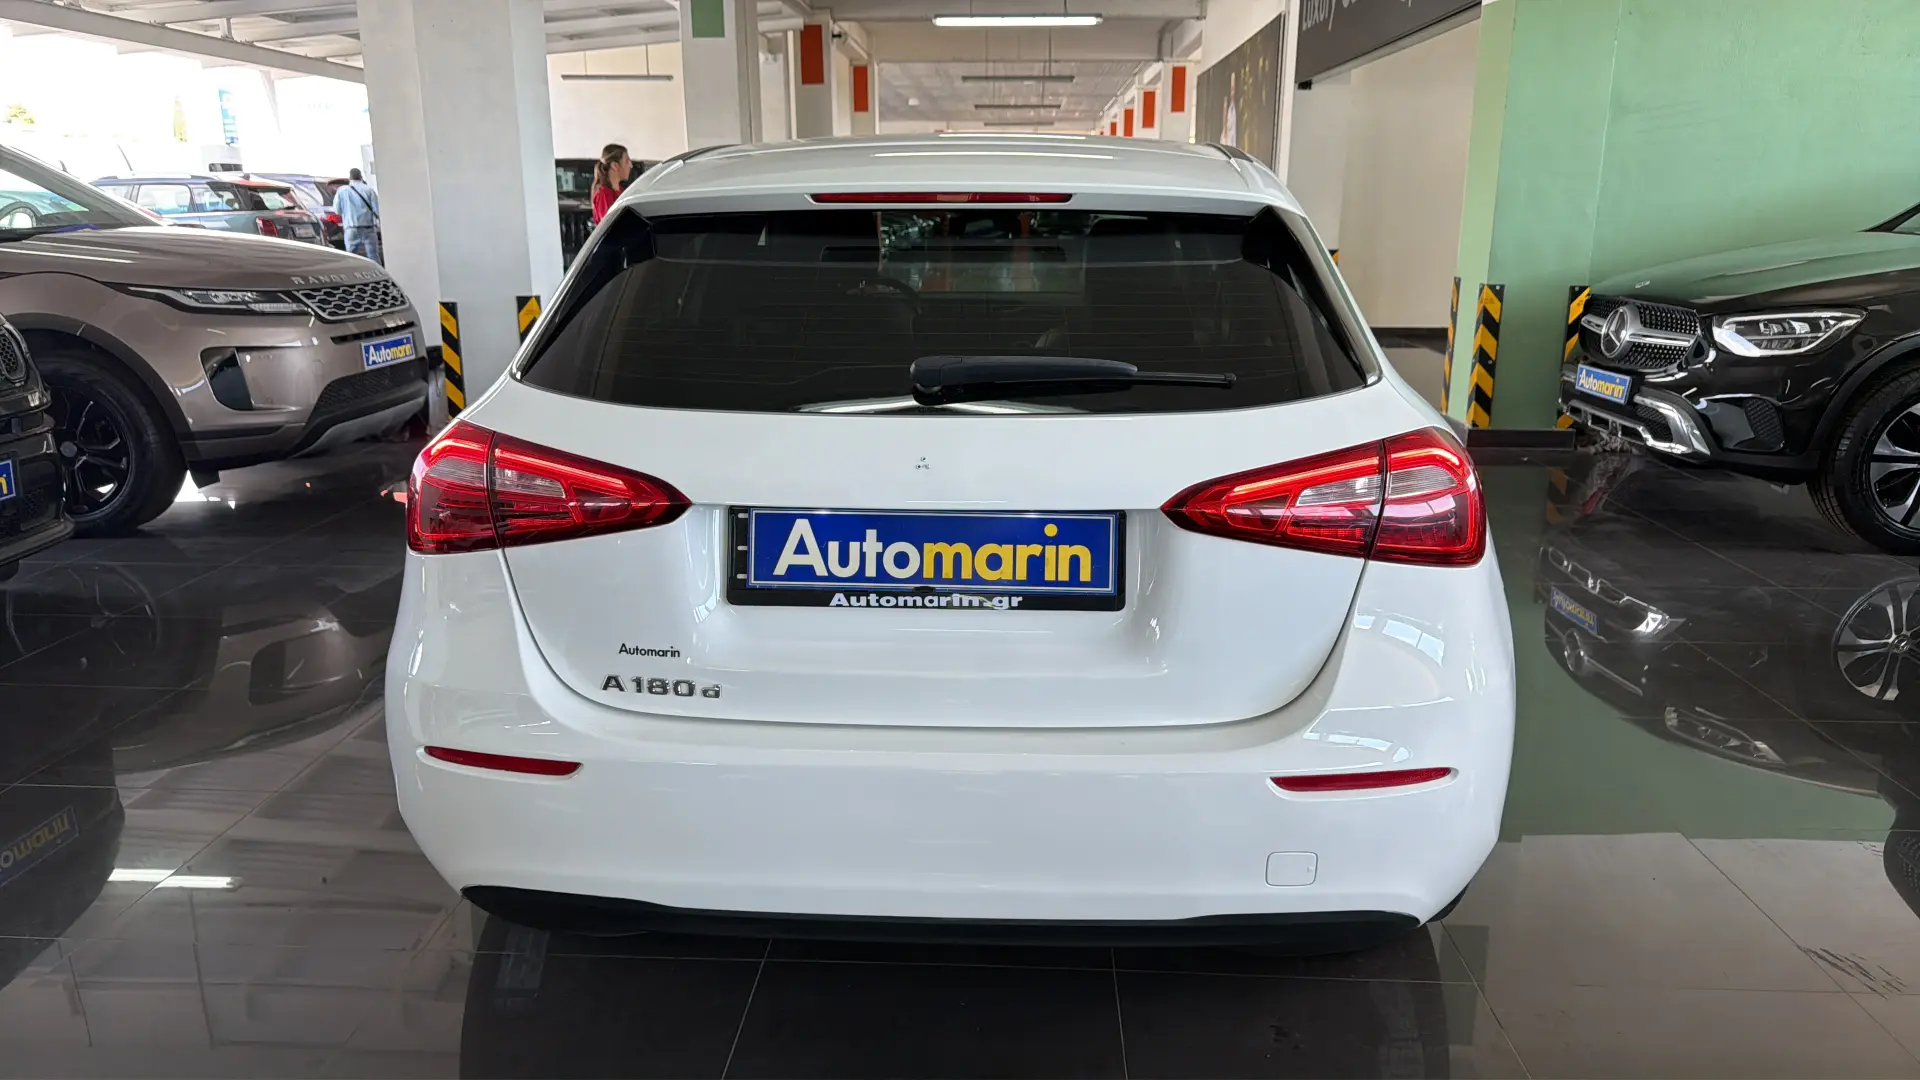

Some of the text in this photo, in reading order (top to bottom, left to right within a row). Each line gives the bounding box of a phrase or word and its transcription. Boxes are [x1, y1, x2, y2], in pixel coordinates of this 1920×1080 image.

[368, 338, 412, 365] Automarin
[1579, 368, 1625, 398] Automarin
[773, 518, 1091, 582] Automarin
[618, 643, 680, 658] Automarin
